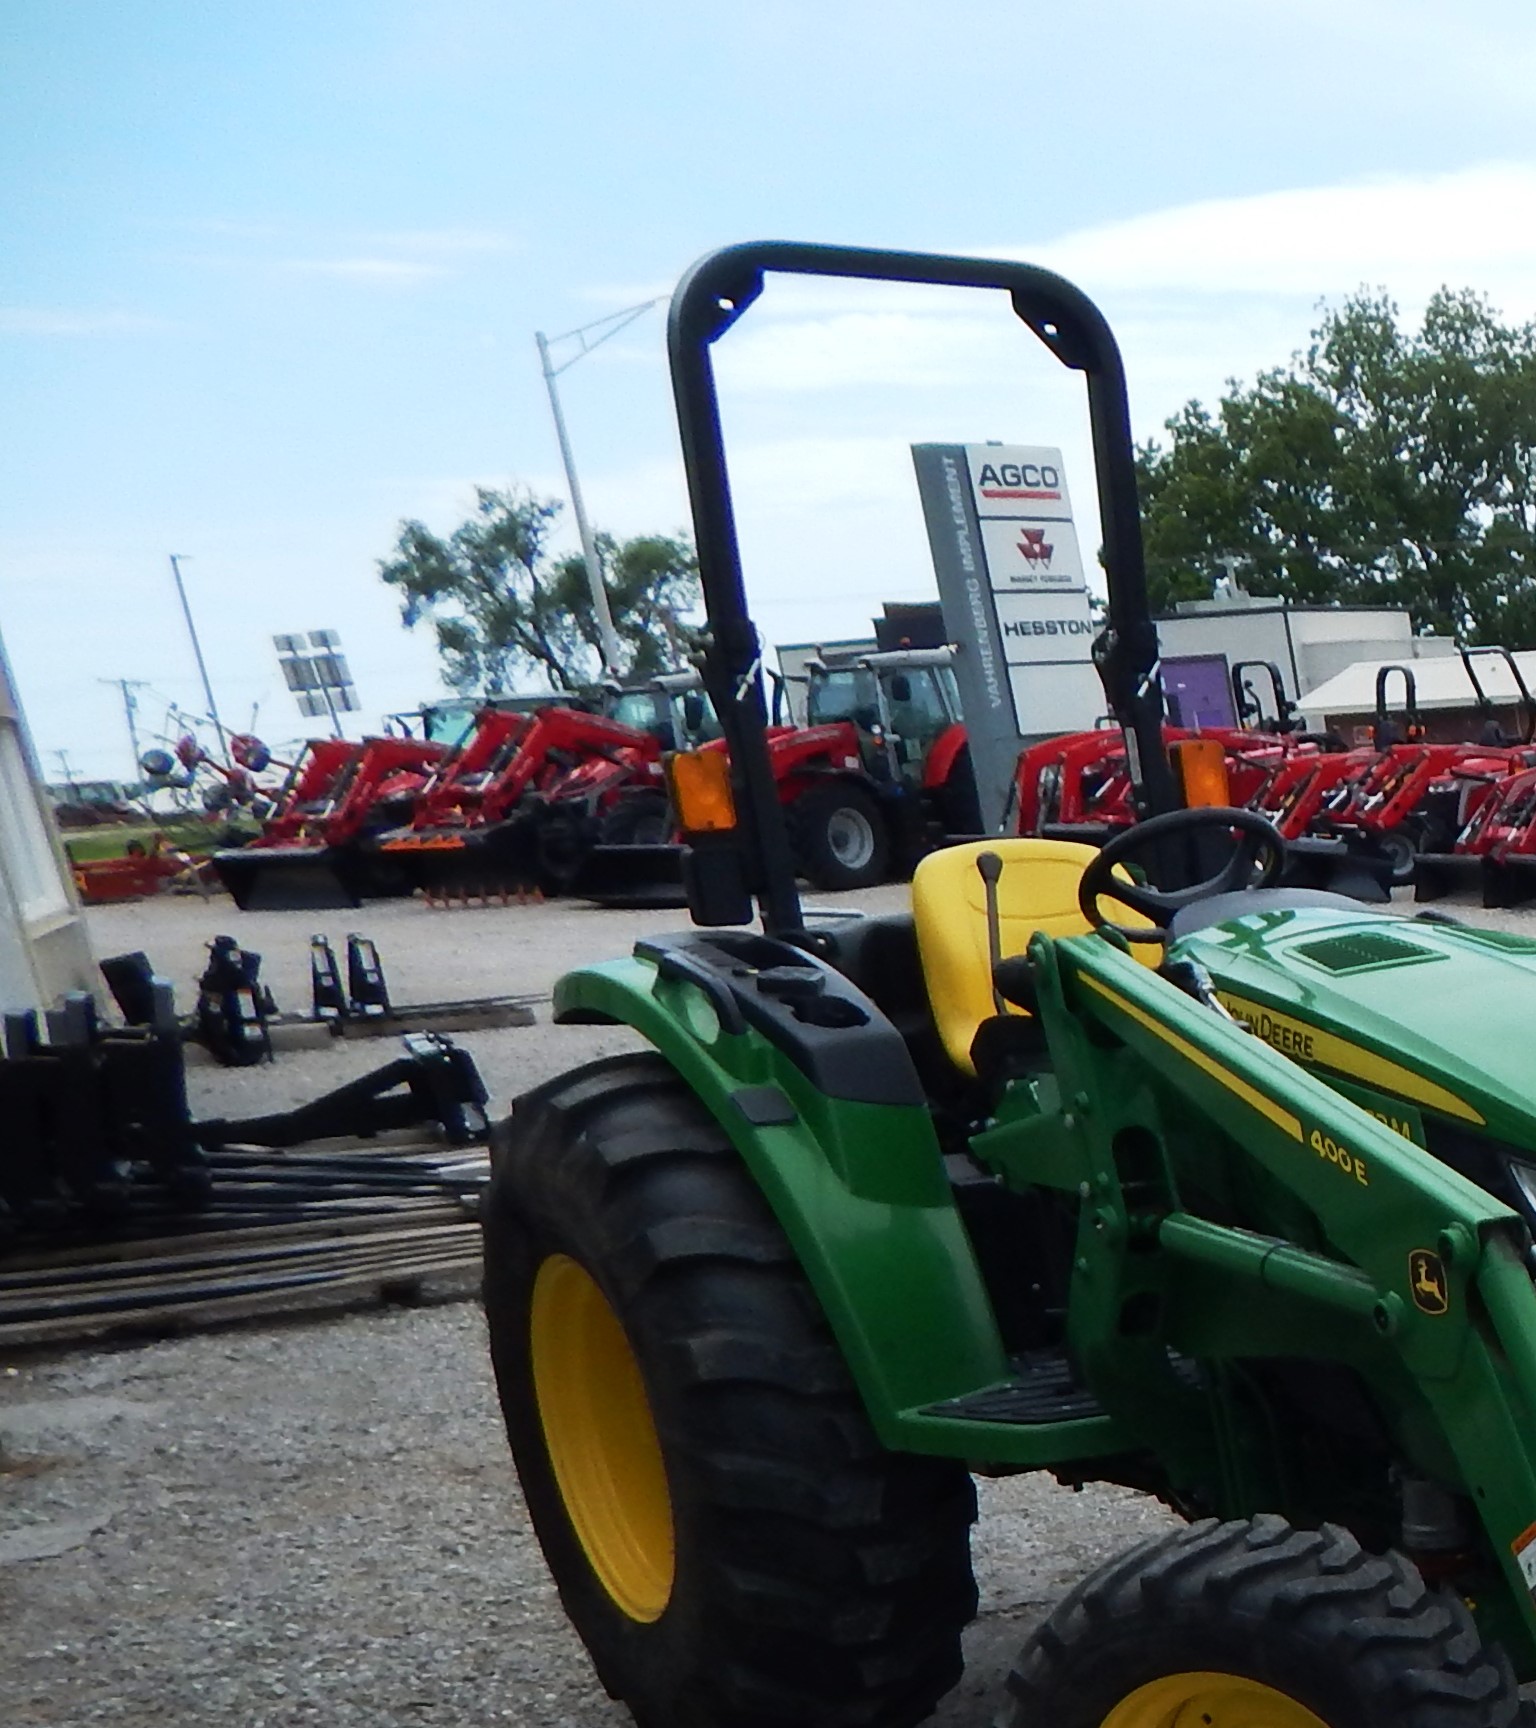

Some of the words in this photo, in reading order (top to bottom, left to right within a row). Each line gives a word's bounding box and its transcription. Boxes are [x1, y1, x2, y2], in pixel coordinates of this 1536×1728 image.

[979, 464, 1059, 488] AGCO
[942, 457, 976, 573] IMPLEMENT
[1003, 620, 1092, 637] HESSTON
[1260, 1013, 1314, 1058] DEERE
[1311, 1130, 1368, 1186] 400E
